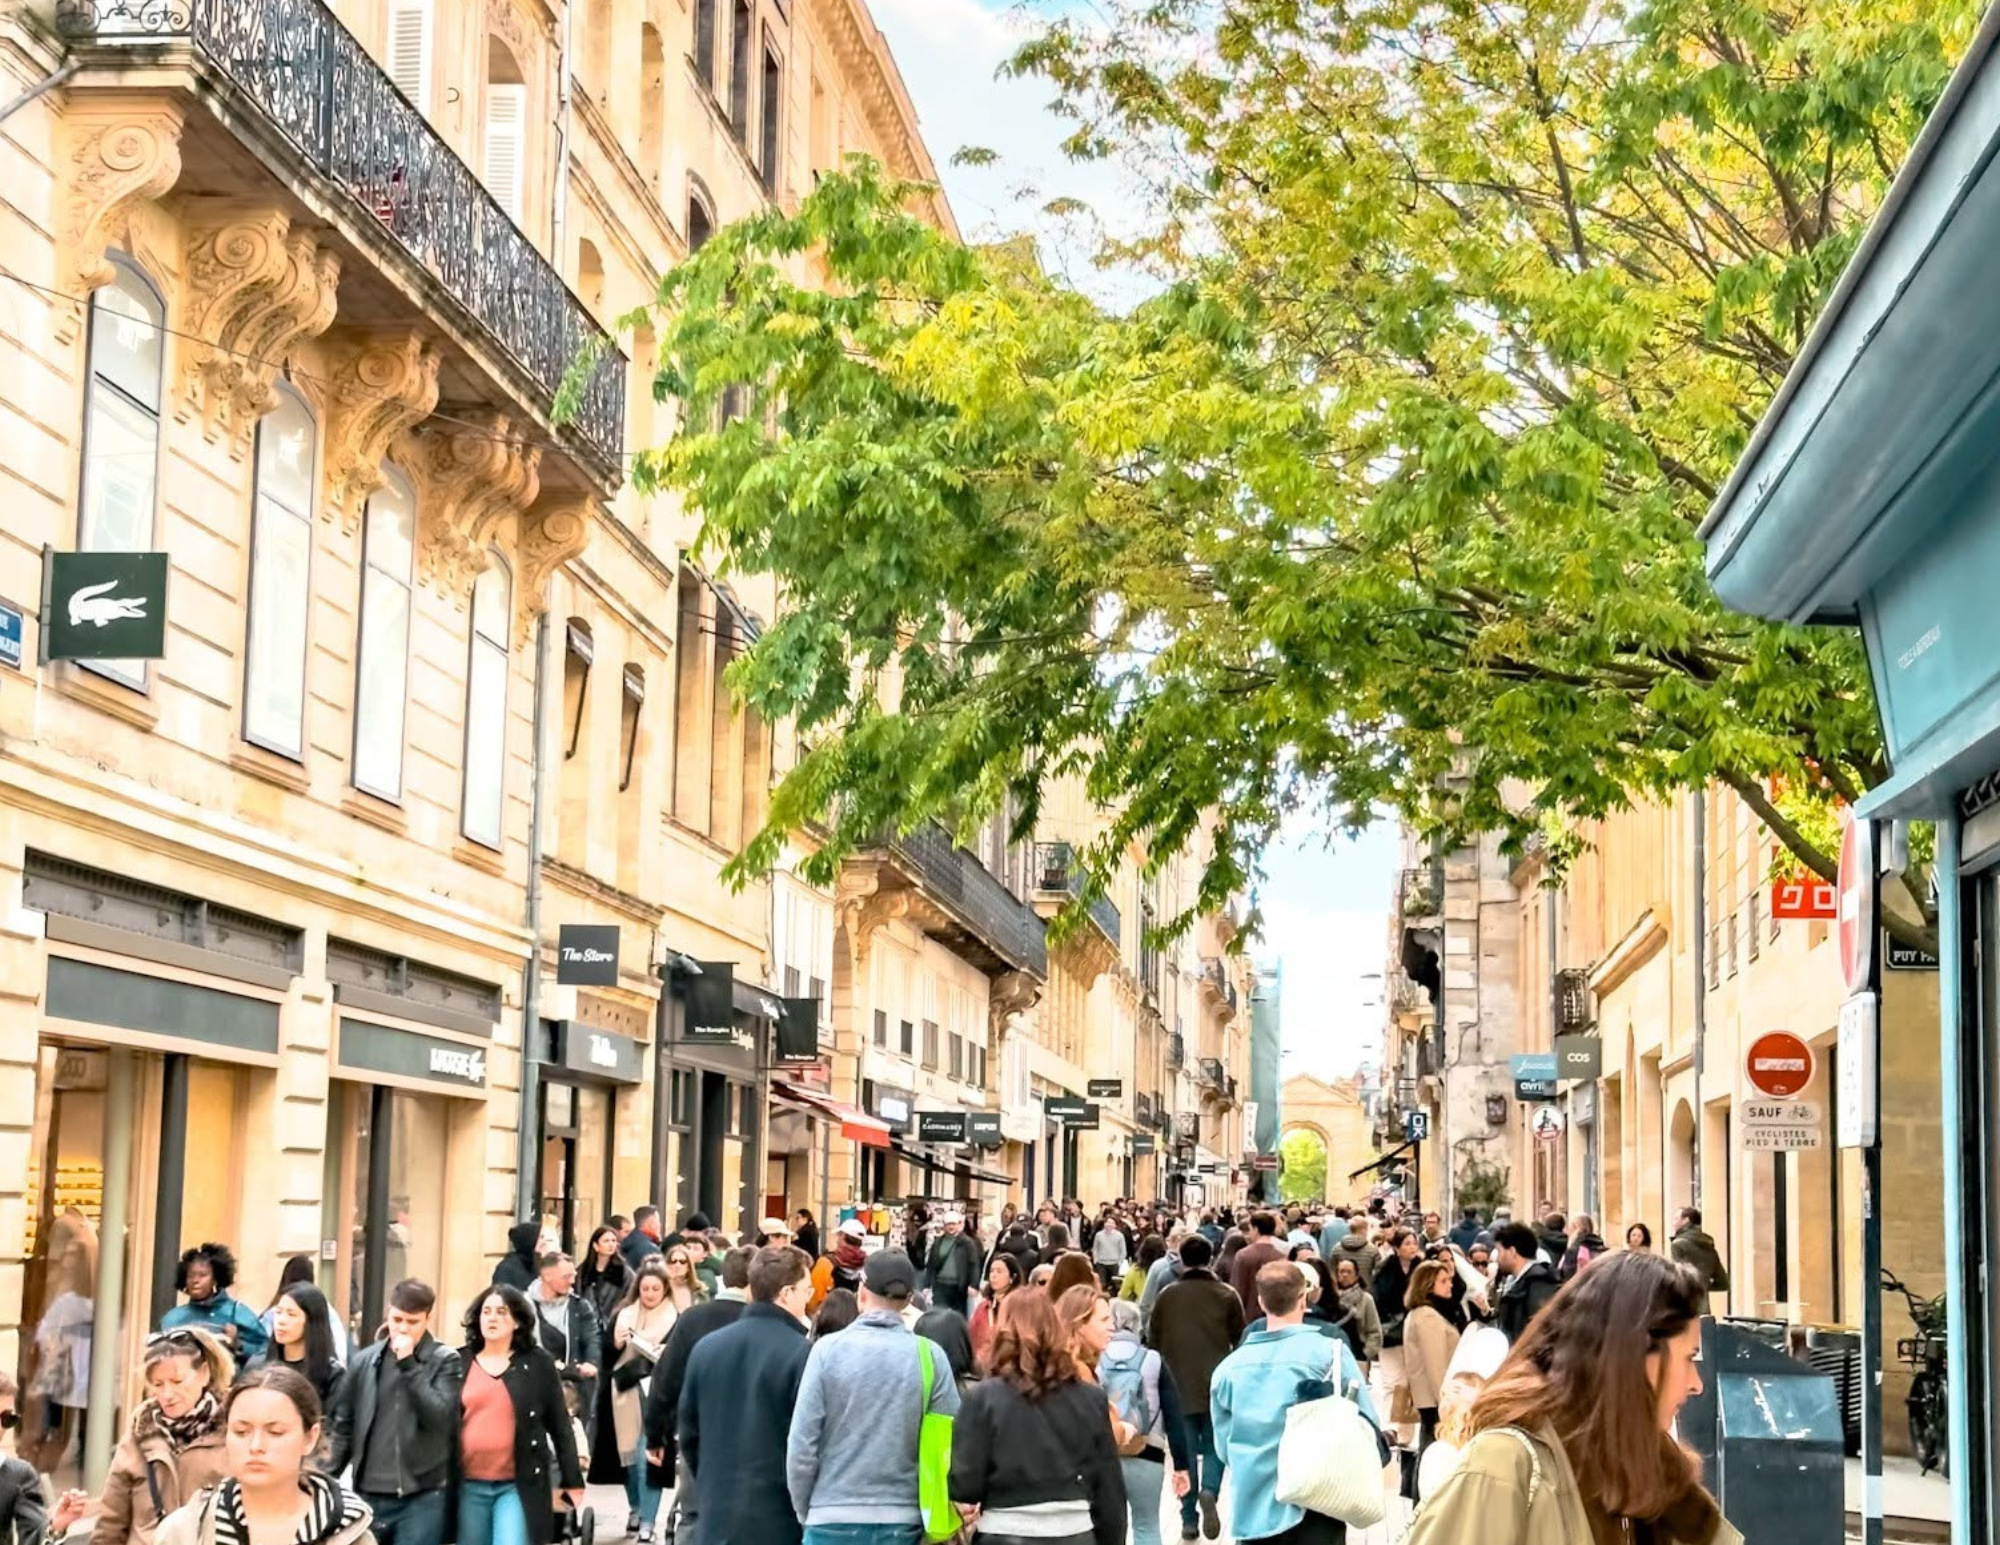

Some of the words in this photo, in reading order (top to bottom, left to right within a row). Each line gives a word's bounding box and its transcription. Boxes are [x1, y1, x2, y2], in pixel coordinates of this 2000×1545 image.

[562, 947, 583, 961] The
[583, 947, 615, 962] Store
[1893, 950, 1917, 962] PUY
[1567, 1053, 1590, 1062] COS
[1749, 1107, 1782, 1117] SAUF
[1755, 1130, 1807, 1138] CYCLISTES
